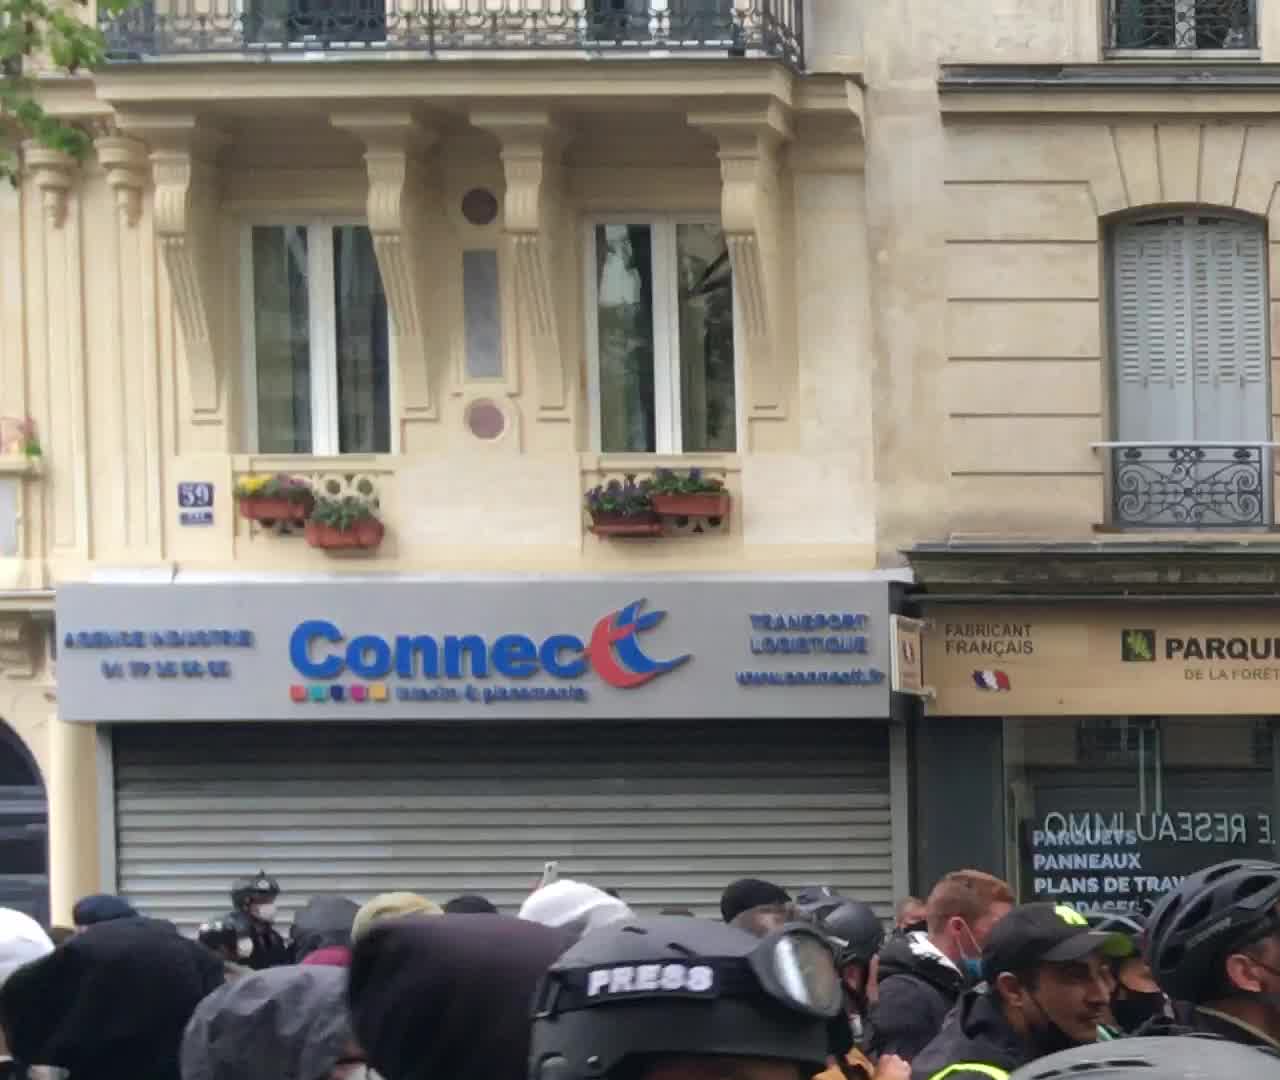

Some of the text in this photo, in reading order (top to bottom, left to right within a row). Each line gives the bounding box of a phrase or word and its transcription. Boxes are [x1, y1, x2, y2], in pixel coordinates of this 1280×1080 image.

[182, 484, 209, 506] 59
[750, 614, 866, 632] TRANSPORT
[945, 624, 1032, 638] FABRICANT
[945, 640, 1034, 657] FRANÇAIS
[1184, 668, 1203, 680] DE
[1210, 668, 1228, 680] LA
[1034, 854, 1141, 870] PANNEAUX
[1035, 877, 1100, 893] PLANS
[1104, 877, 1131, 892] DE
[587, 963, 714, 997] PRESS
